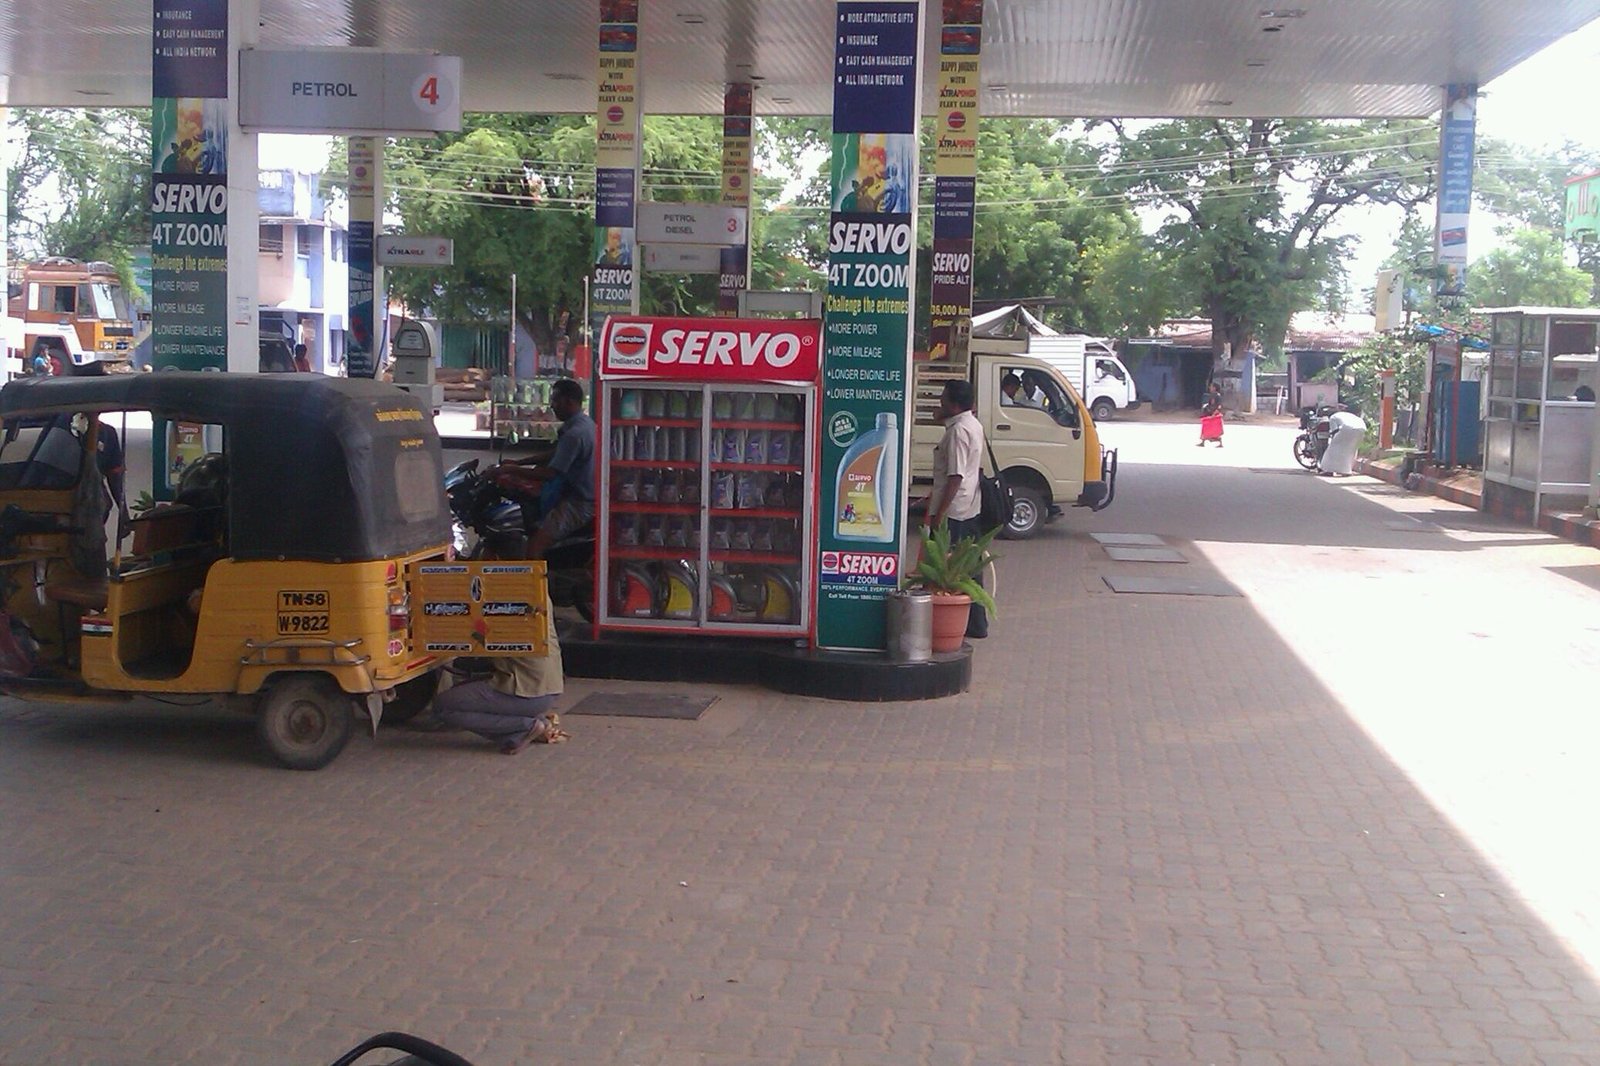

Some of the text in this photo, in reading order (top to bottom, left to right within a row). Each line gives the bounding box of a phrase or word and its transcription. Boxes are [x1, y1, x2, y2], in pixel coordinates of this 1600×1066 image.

[848, 13, 913, 23] MORE ATTRACTIVE GIFTS
[847, 35, 878, 45] INSURANCE
[846, 55, 913, 66] EASY CASH MANAGEMENT
[846, 75, 904, 85] ALL INDIA NETWORK
[292, 82, 357, 97] PETROL
[420, 77, 439, 105] 4
[152, 182, 227, 214] SERVO
[664, 214, 696, 223] PETROL
[727, 218, 737, 232] 3
[152, 223, 227, 246] 4T ZOOM
[829, 221, 911, 255] SERVO
[439, 246, 446, 256] 2
[933, 252, 969, 272] SERVO
[594, 268, 632, 285] SERVO
[720, 274, 745, 288] SERVO
[829, 263, 909, 288] 4T ZOOM
[934, 275, 970, 285] PRIDE ALT
[594, 288, 632, 300] 4T ZOOM
[827, 294, 908, 316] Challenge the extremes
[832, 323, 878, 335] MORE POWER
[654, 329, 800, 368] SERVO
[832, 346, 882, 358] MORE MILEAGE
[610, 356, 646, 366] IndianOil
[831, 369, 900, 381] LONGER ENGINE LIFE
[830, 388, 903, 400] LOWER MAINTENANCE
[840, 554, 895, 575] SERVO
[857, 576, 878, 584] ZOOM
